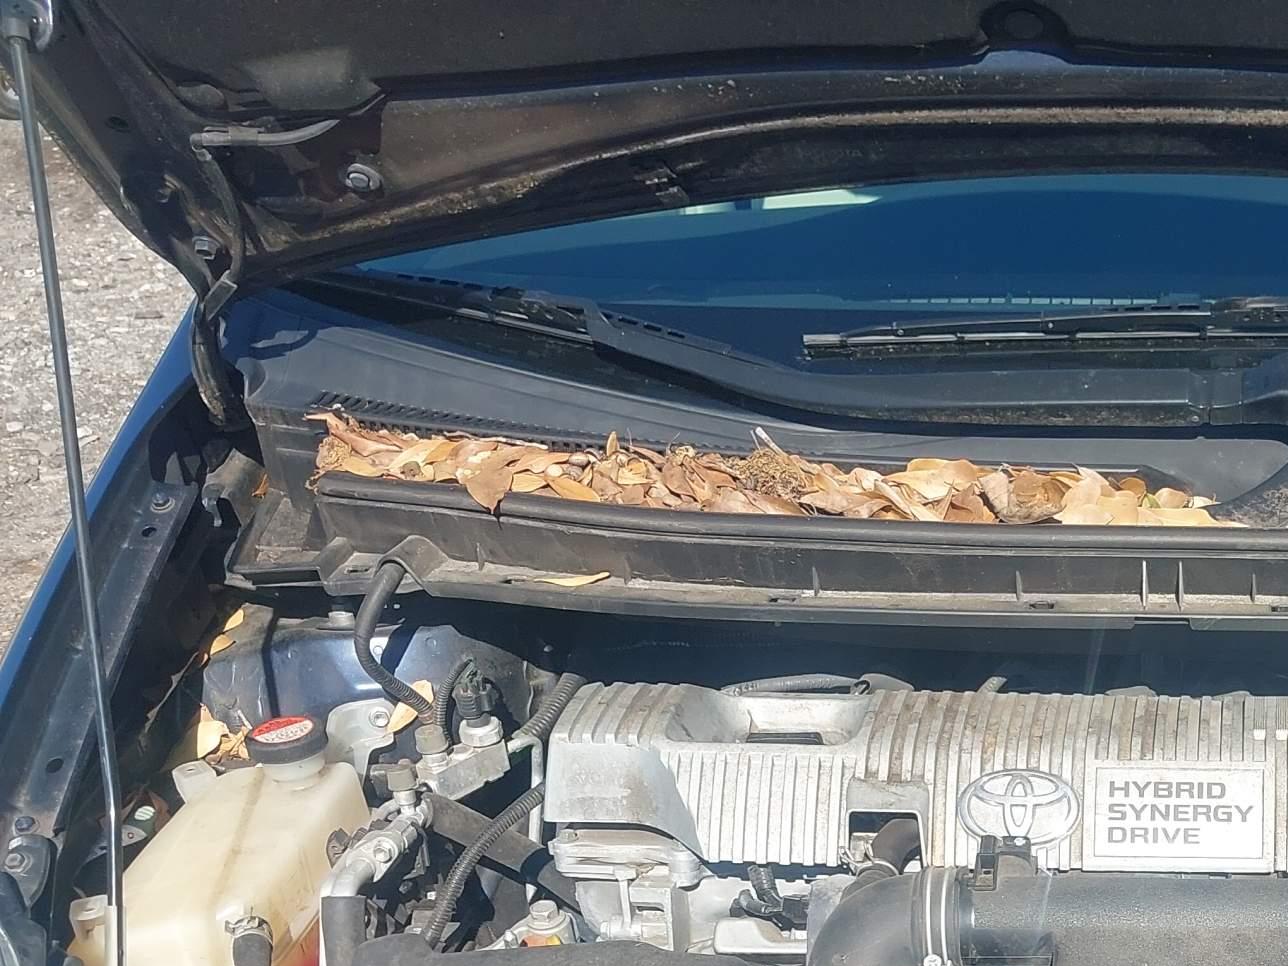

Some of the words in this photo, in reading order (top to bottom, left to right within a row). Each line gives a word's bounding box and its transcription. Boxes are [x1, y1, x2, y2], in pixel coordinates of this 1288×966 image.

[1108, 780, 1227, 800] HYBRID
[1107, 803, 1255, 823] SYNERGY
[1107, 825, 1201, 845] DRIVE
